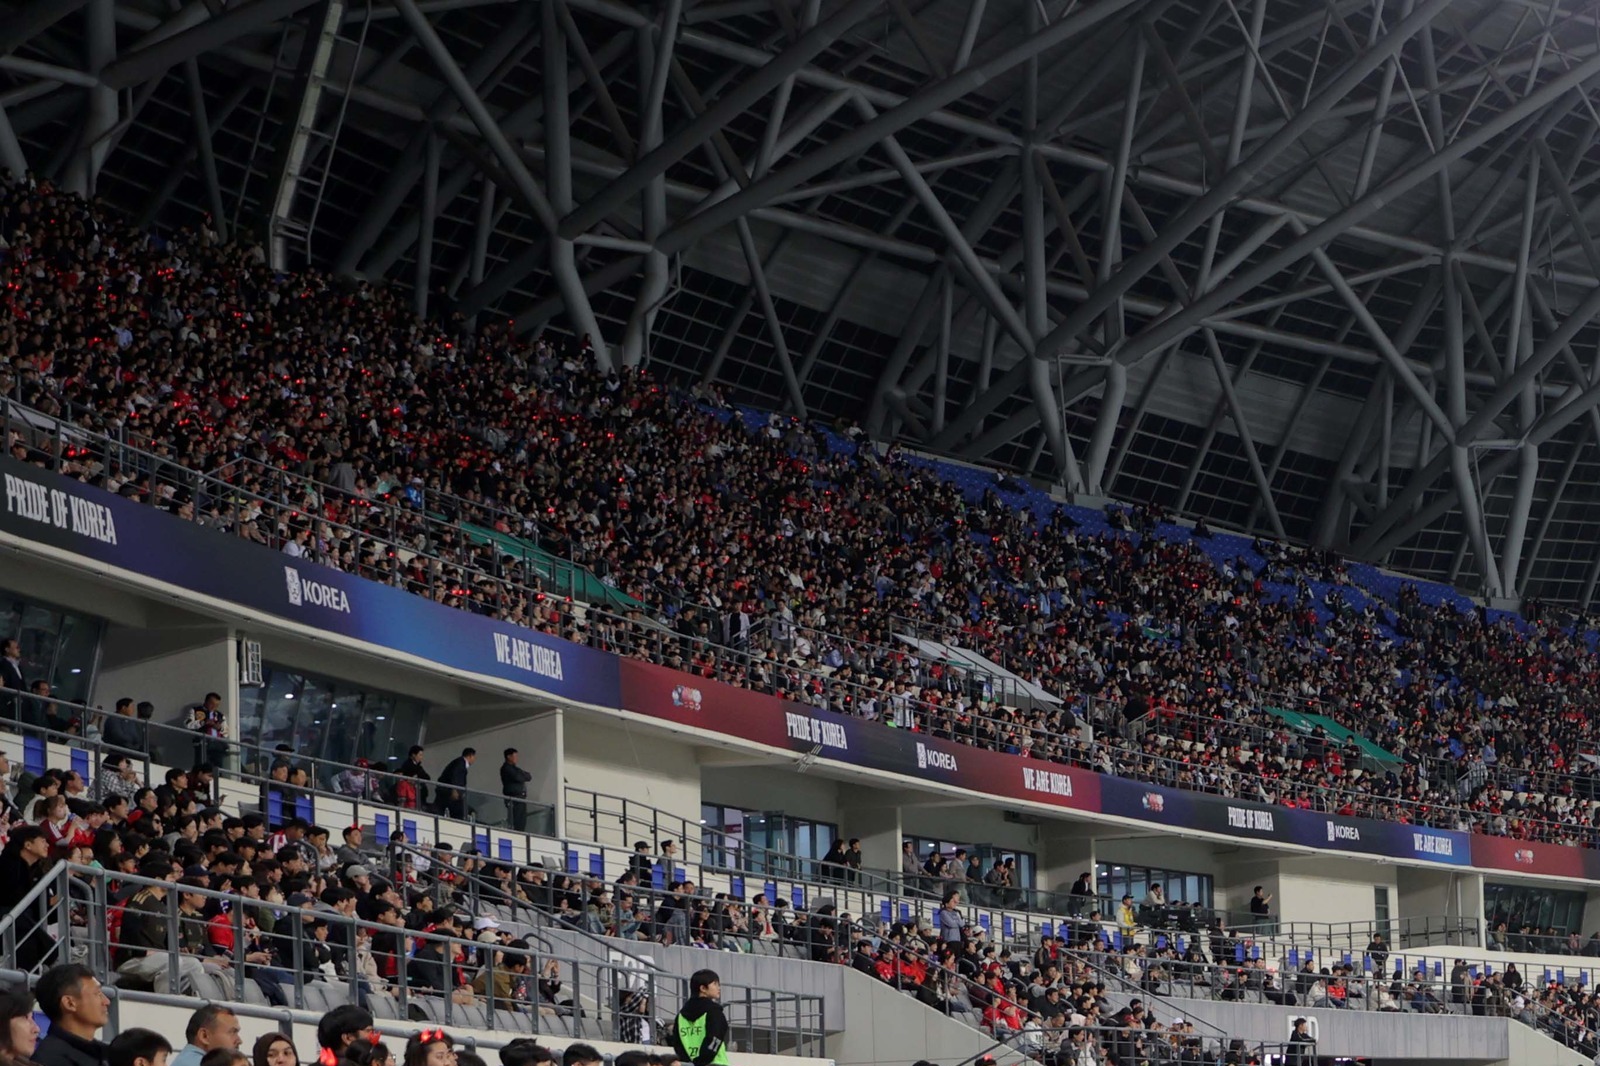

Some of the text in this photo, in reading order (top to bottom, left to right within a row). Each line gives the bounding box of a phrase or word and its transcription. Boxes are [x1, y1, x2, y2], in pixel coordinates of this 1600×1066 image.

[4, 473, 117, 545] PRIDE OF KOREA
[302, 579, 351, 613] KOREA
[493, 632, 563, 680] WE ARE KOREA
[785, 712, 848, 749] PRIDE OF KOREA
[927, 750, 957, 771] KOREA
[1023, 767, 1072, 797] WE ARE KOREA
[1228, 806, 1274, 831] PRIDE OF KOREA
[1335, 825, 1360, 840] KOREA
[1413, 833, 1453, 855] WE ARE KOREA
[1287, 1015, 1319, 1042] ED
